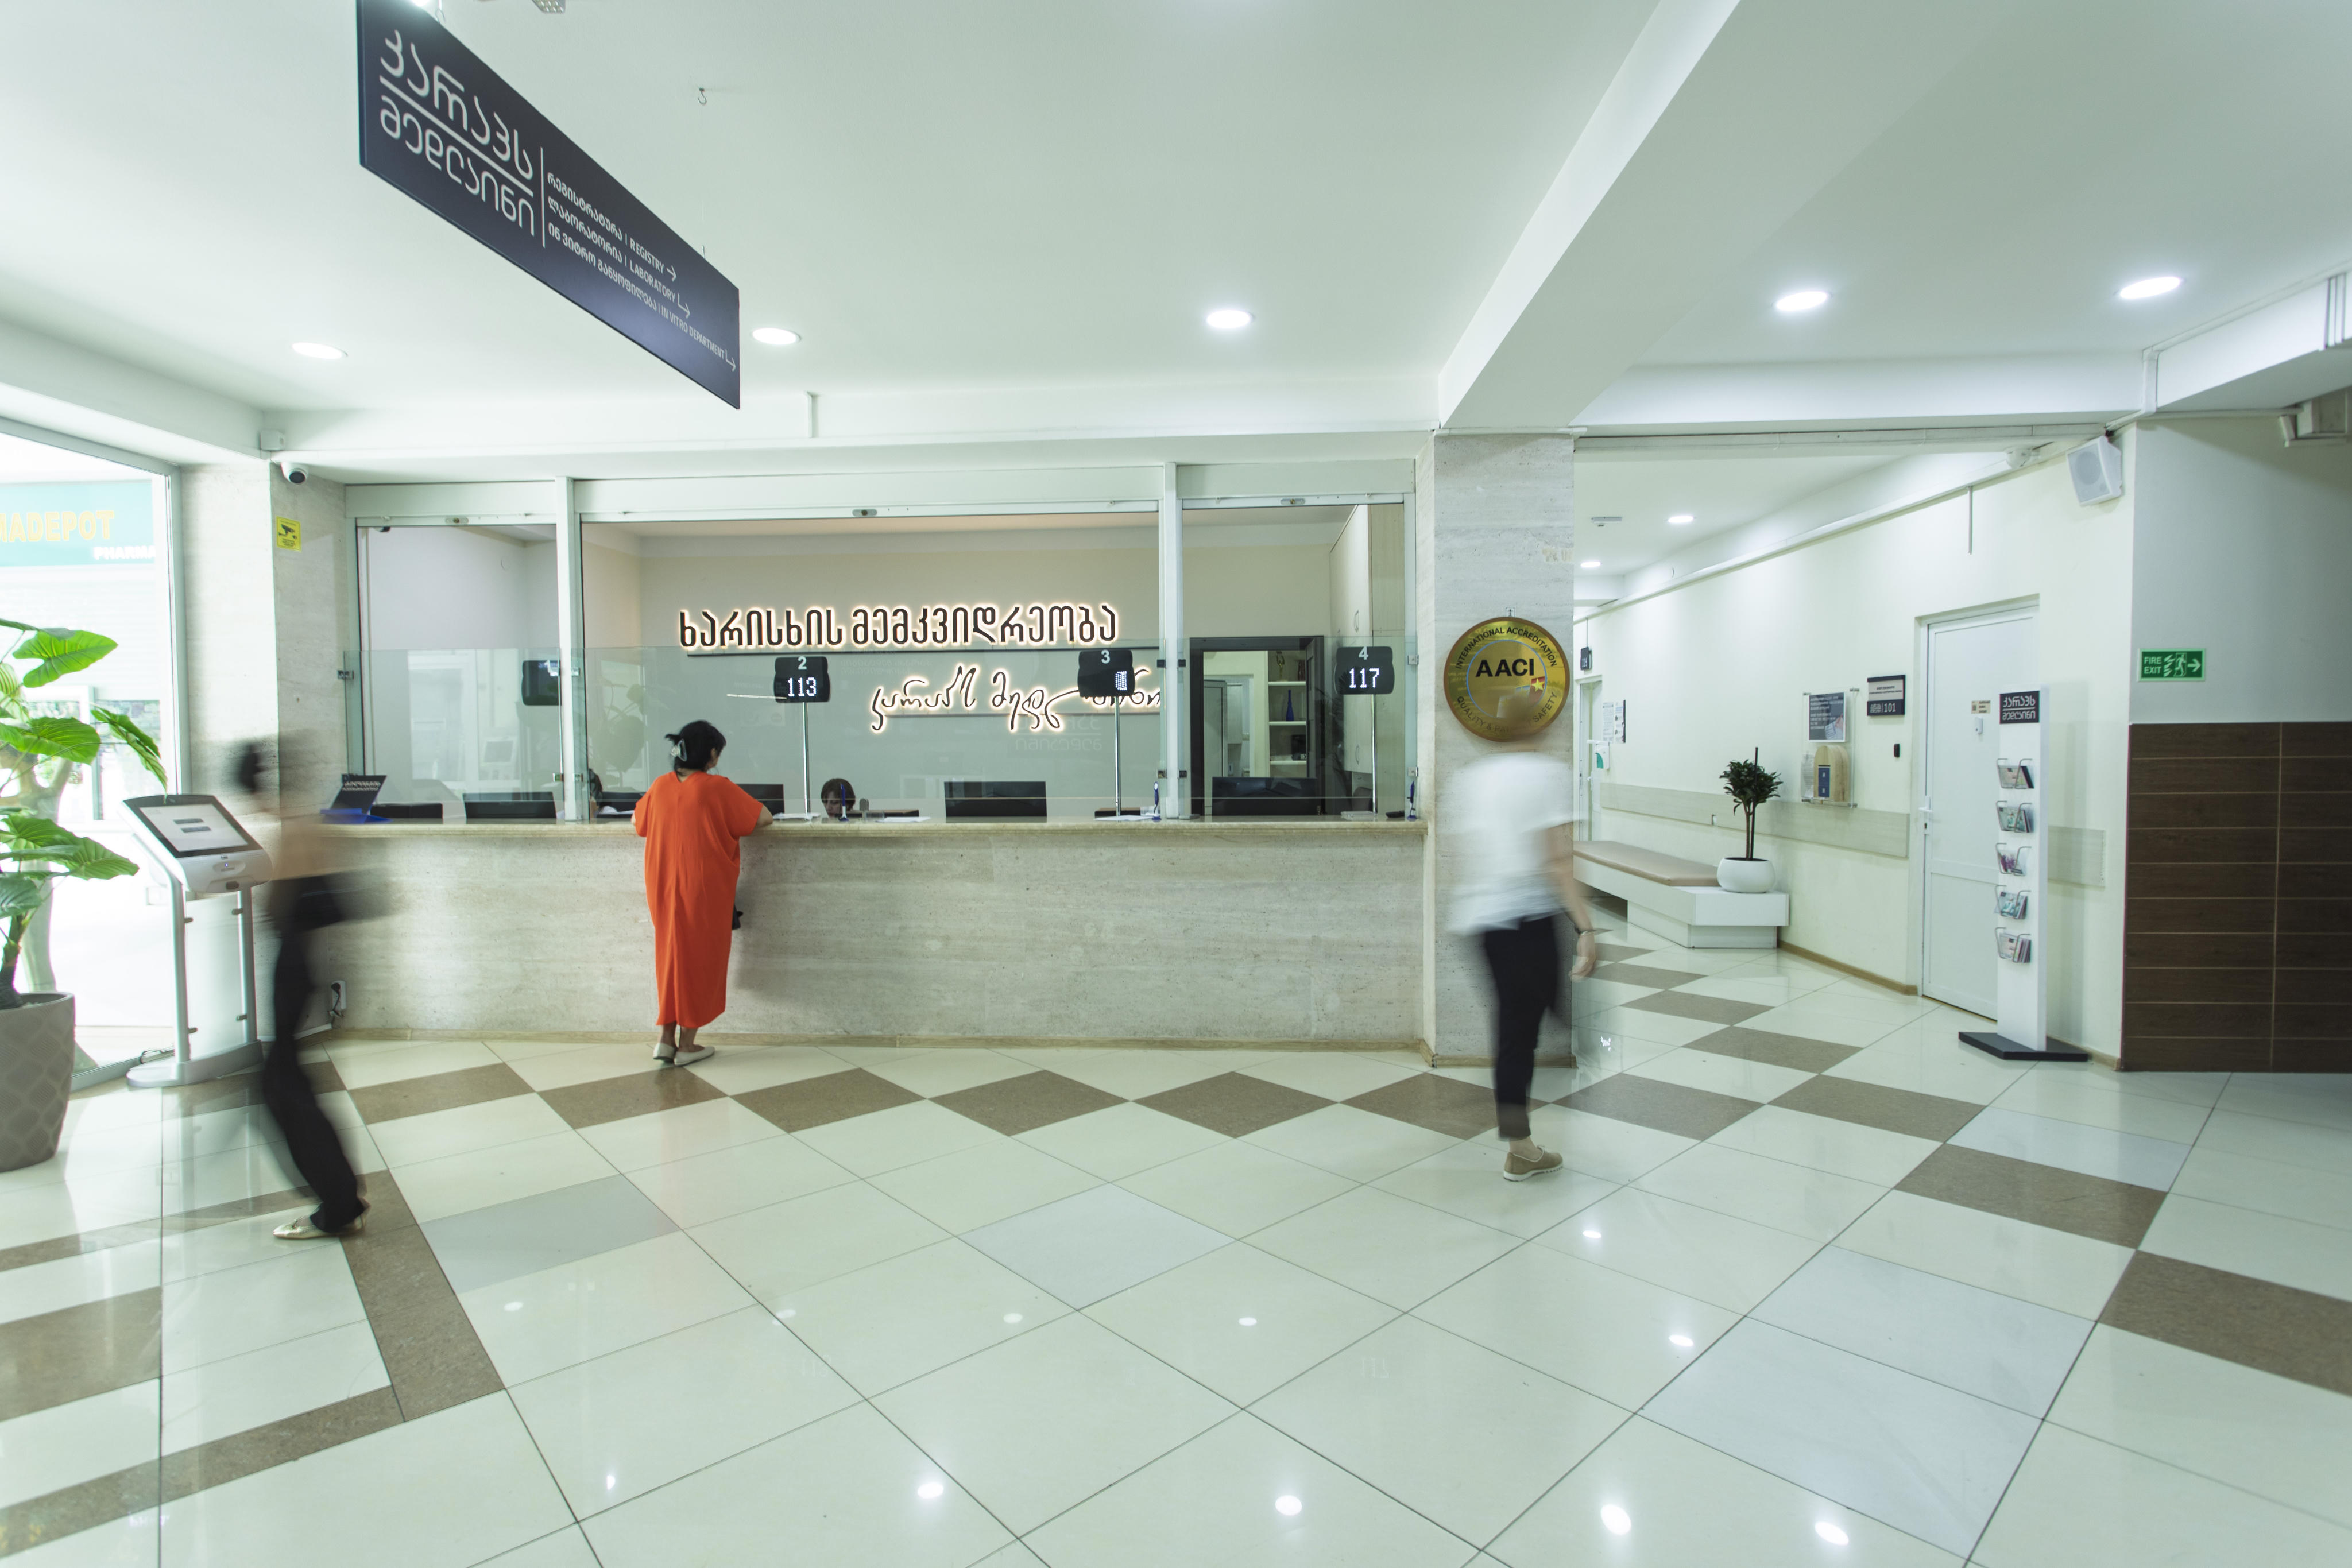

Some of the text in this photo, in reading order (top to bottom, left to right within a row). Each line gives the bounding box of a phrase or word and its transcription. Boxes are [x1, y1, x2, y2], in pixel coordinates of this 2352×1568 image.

[630, 237, 664, 274] REGISTRY
[548, 222, 561, 241] ინ
[562, 232, 596, 268] ვიტრო
[661, 304, 668, 320] IN
[670, 312, 688, 334] VITRO
[689, 326, 725, 359] DEPARTMENT
[630, 260, 675, 303] LABORATORY
[679, 605, 1116, 647] ხარისხის მემკვიდრეობა
[1101, 649, 1111, 664] 3
[1359, 646, 1369, 660] 4
[1456, 626, 1558, 669] INTERNATIONAL ACCREDITATION
[798, 656, 807, 670] 2
[1475, 658, 1534, 677] AACI
[2144, 656, 2162, 665] FIRE
[2144, 666, 2161, 675] EXIT
[788, 677, 817, 697] 113
[1349, 668, 1379, 688] 117
[1457, 695, 1485, 727] QUALITY
[1533, 691, 1558, 723] SAFETY
[1884, 703, 1896, 713] 101
